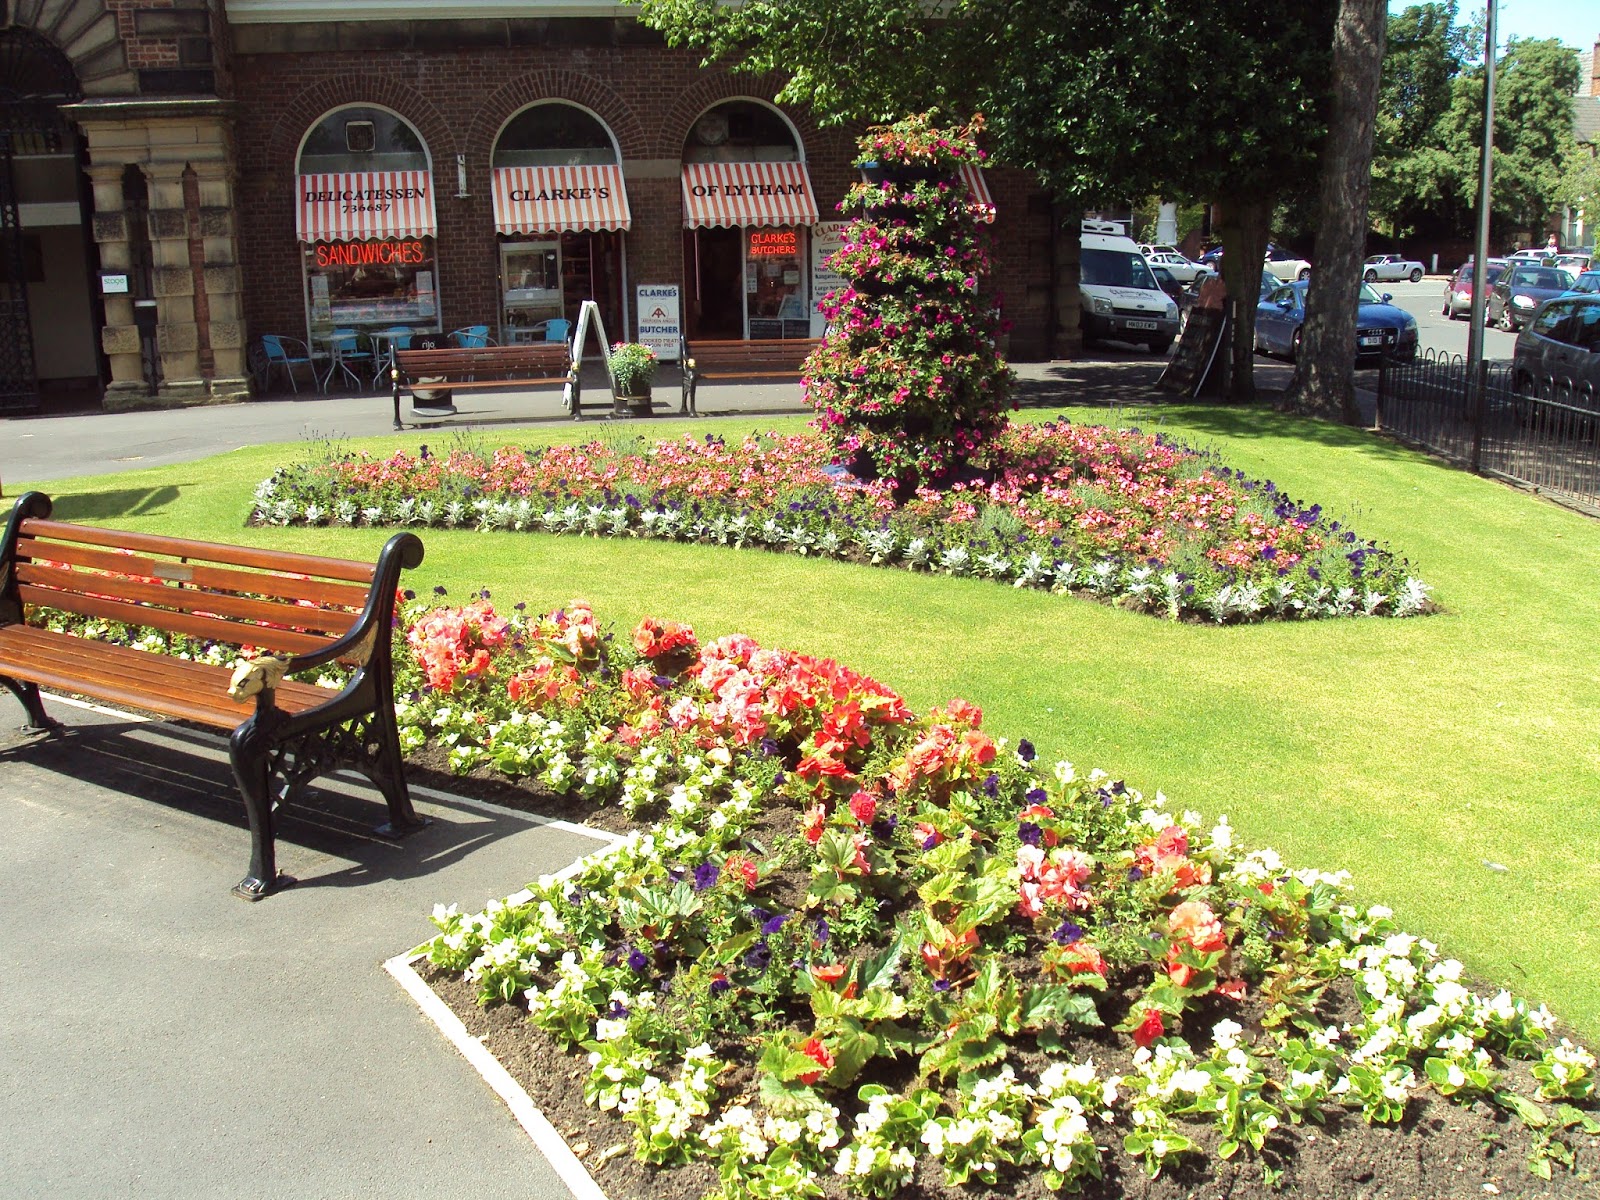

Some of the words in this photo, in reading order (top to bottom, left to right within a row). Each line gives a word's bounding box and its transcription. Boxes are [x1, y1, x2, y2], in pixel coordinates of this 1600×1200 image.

[304, 188, 426, 203] DELICATESSEN
[510, 187, 609, 202] CLARKE'S
[692, 185, 718, 197] OF
[724, 184, 804, 196] LYTHAM
[342, 203, 391, 214] 736687
[751, 232, 796, 244] CLARKE'S
[316, 242, 423, 267] SANDWICHES
[751, 245, 796, 254] BUTCHERS
[639, 288, 677, 297] CLARKE'S
[640, 326, 678, 334] BUTCHER
